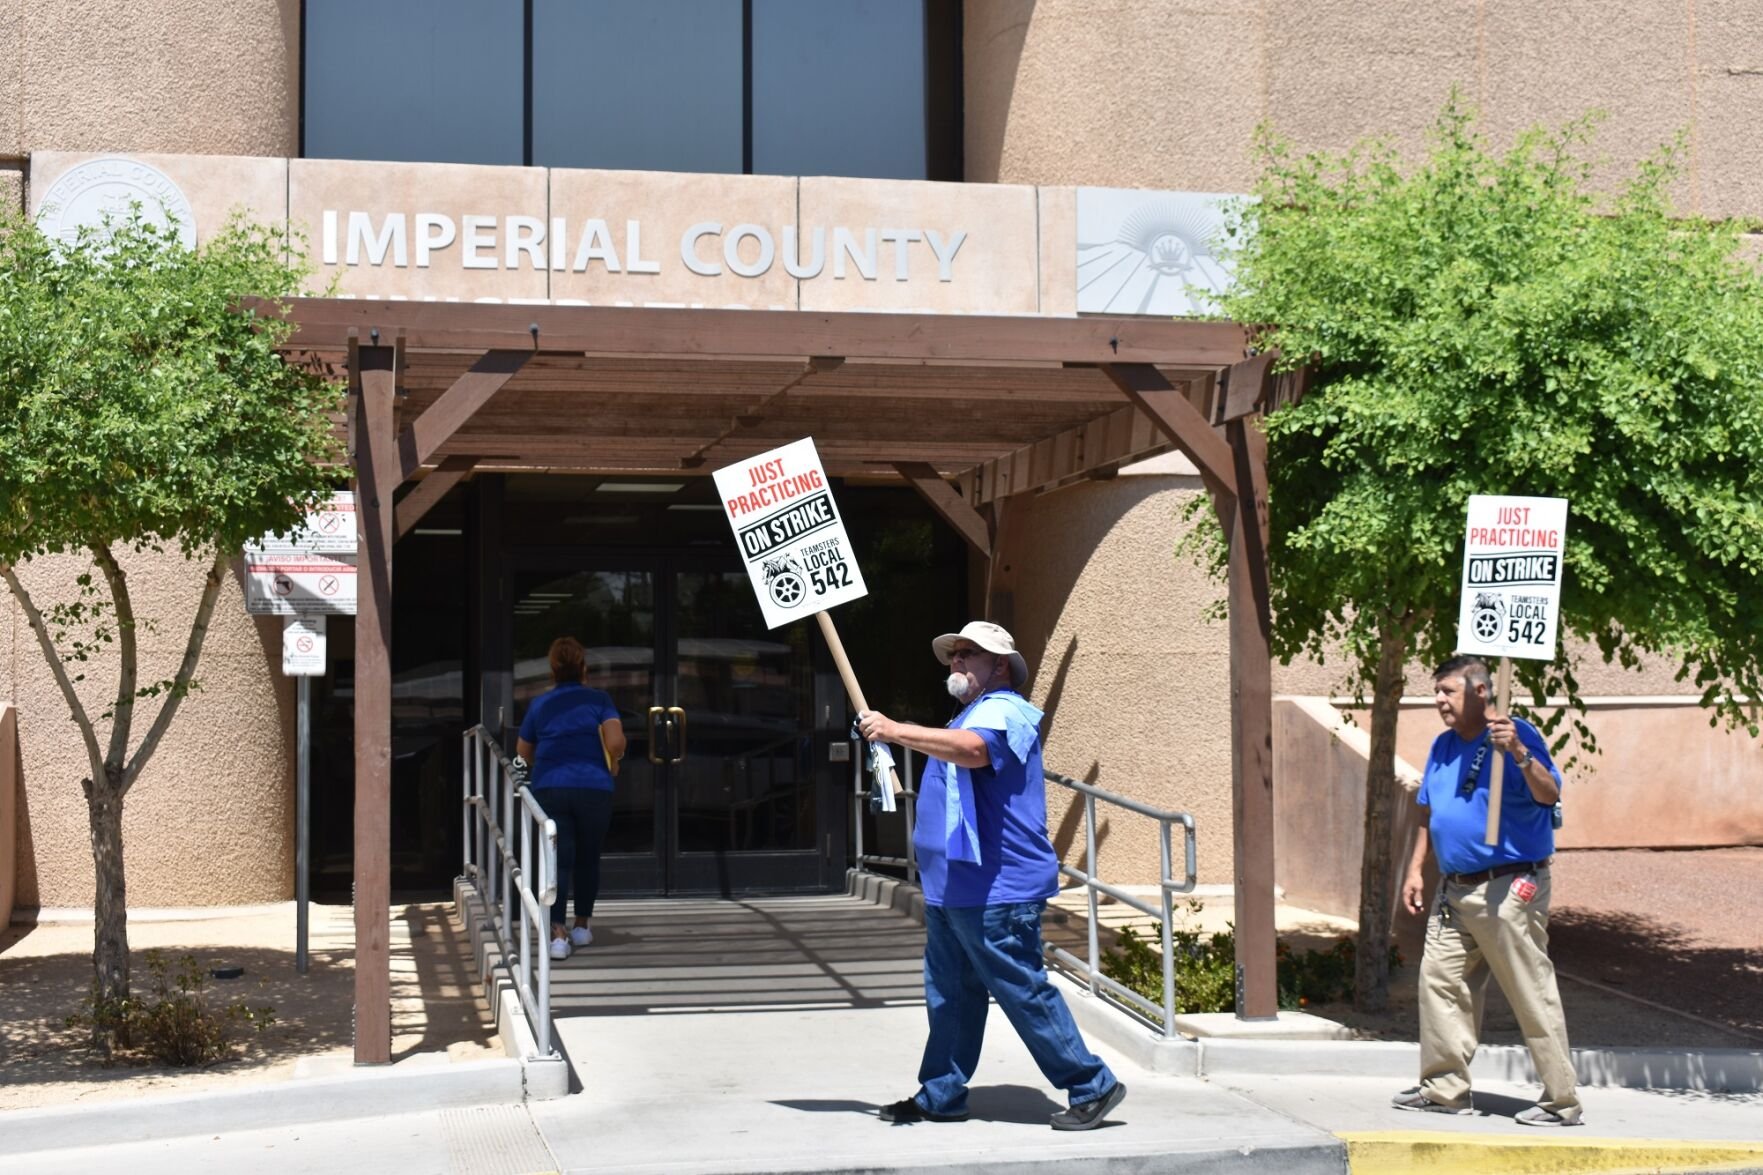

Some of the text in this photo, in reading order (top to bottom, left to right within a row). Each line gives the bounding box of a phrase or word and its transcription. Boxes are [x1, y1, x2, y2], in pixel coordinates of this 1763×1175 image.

[323, 210, 967, 282] IMPERIAL COUNTY
[749, 458, 785, 487] JUST
[727, 470, 823, 518] PRACTICING
[745, 497, 831, 555] ON STRIKE
[1497, 507, 1531, 525] JUST
[800, 537, 840, 556] TEAMSTERS
[1470, 528, 1558, 548] PRACTICING
[803, 547, 844, 572] LOCAL
[1470, 556, 1553, 582] ON STRIKE
[810, 562, 853, 596] 542
[1509, 604, 1547, 620] LOCAL
[1511, 595, 1549, 605] TEAMSTERS
[1508, 620, 1546, 645] 542
